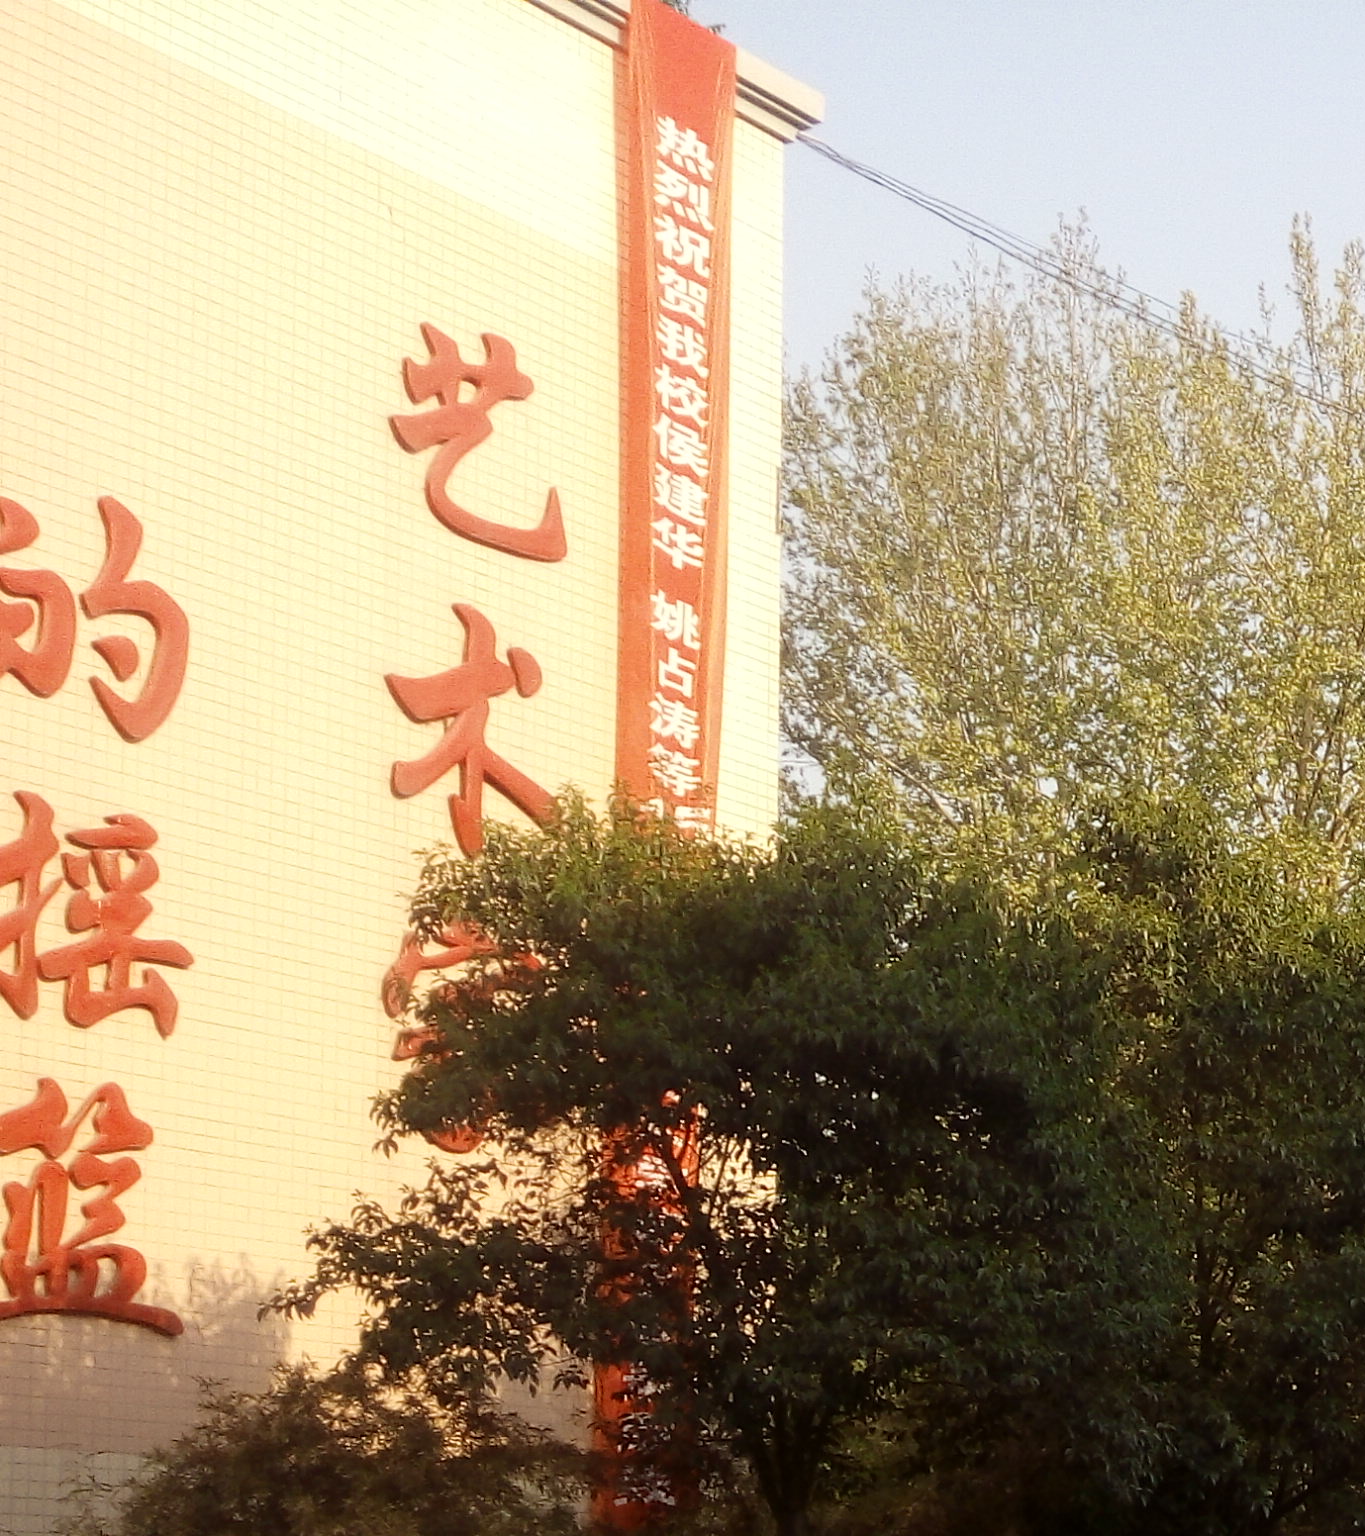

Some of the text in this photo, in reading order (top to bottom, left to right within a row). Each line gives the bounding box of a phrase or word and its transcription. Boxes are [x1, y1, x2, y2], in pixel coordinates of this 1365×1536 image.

[652, 116, 714, 571] 热烈祝贺我校侯建华
[648, 590, 701, 797] 姚占涛等
